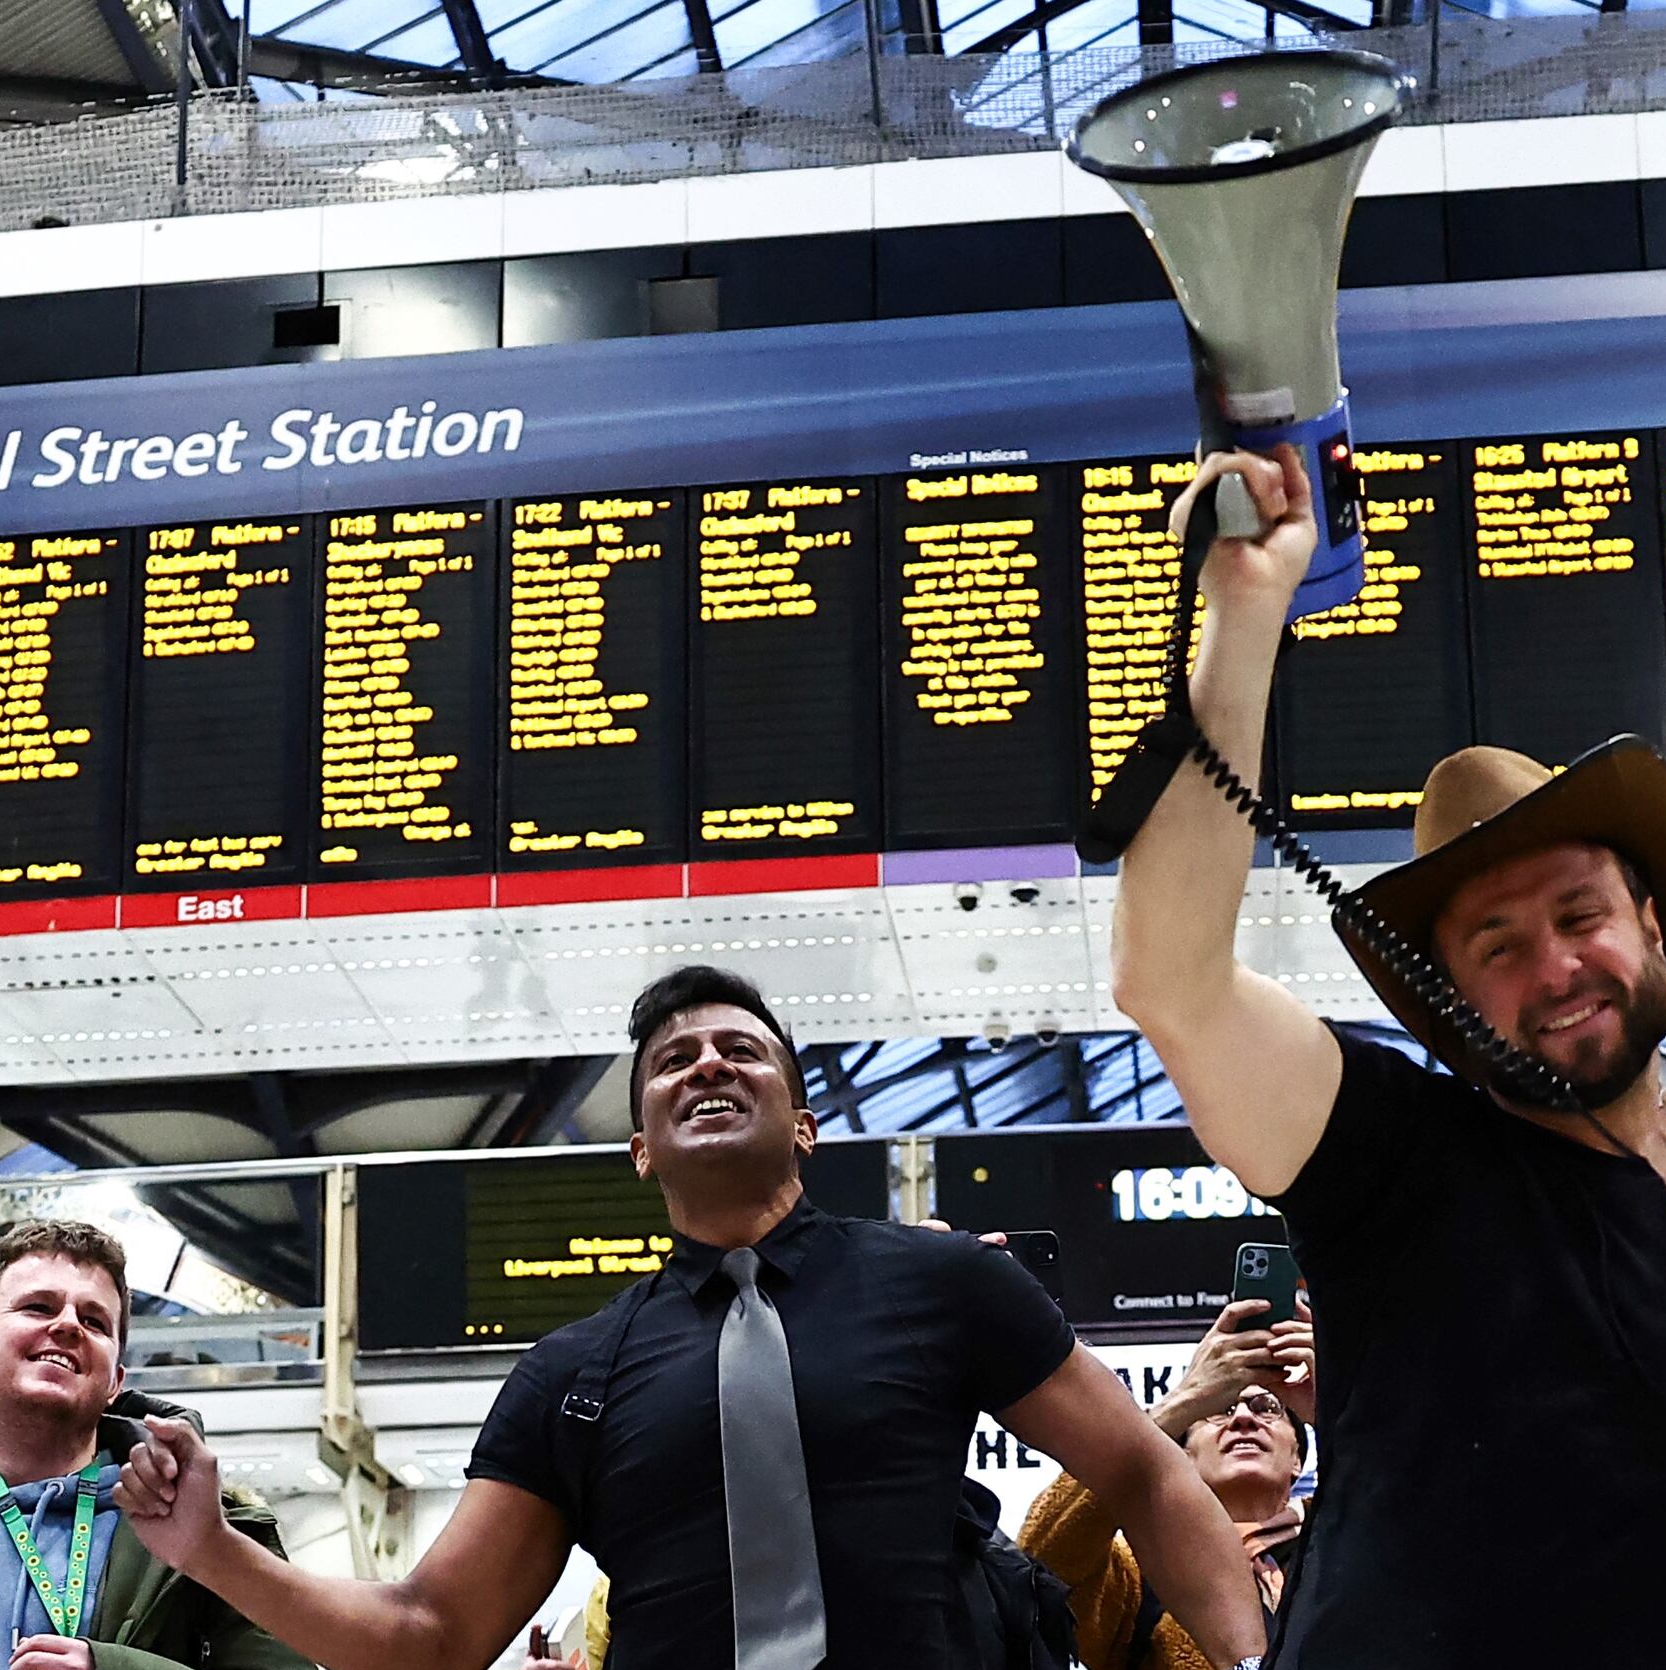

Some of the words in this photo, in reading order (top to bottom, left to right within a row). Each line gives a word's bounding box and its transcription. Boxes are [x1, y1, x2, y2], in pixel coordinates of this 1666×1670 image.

[33, 417, 249, 489] Street
[262, 397, 526, 471] Station
[1543, 441, 1619, 461] Platform
[909, 451, 967, 468] Special
[970, 448, 1029, 464] Notices
[768, 486, 842, 507] Platform
[907, 476, 967, 501] Special
[972, 473, 1038, 494] Notices
[580, 499, 652, 519] Platform
[393, 512, 465, 532] Platform
[212, 524, 282, 545] Platform
[32, 537, 100, 557] Platform
[177, 894, 244, 921] East
[649, 1236, 672, 1251] to
[504, 1257, 594, 1278] Liverpool
[1114, 1293, 1174, 1309] Connect
[1177, 1293, 1194, 1307] to
[1197, 1291, 1229, 1306] Free
